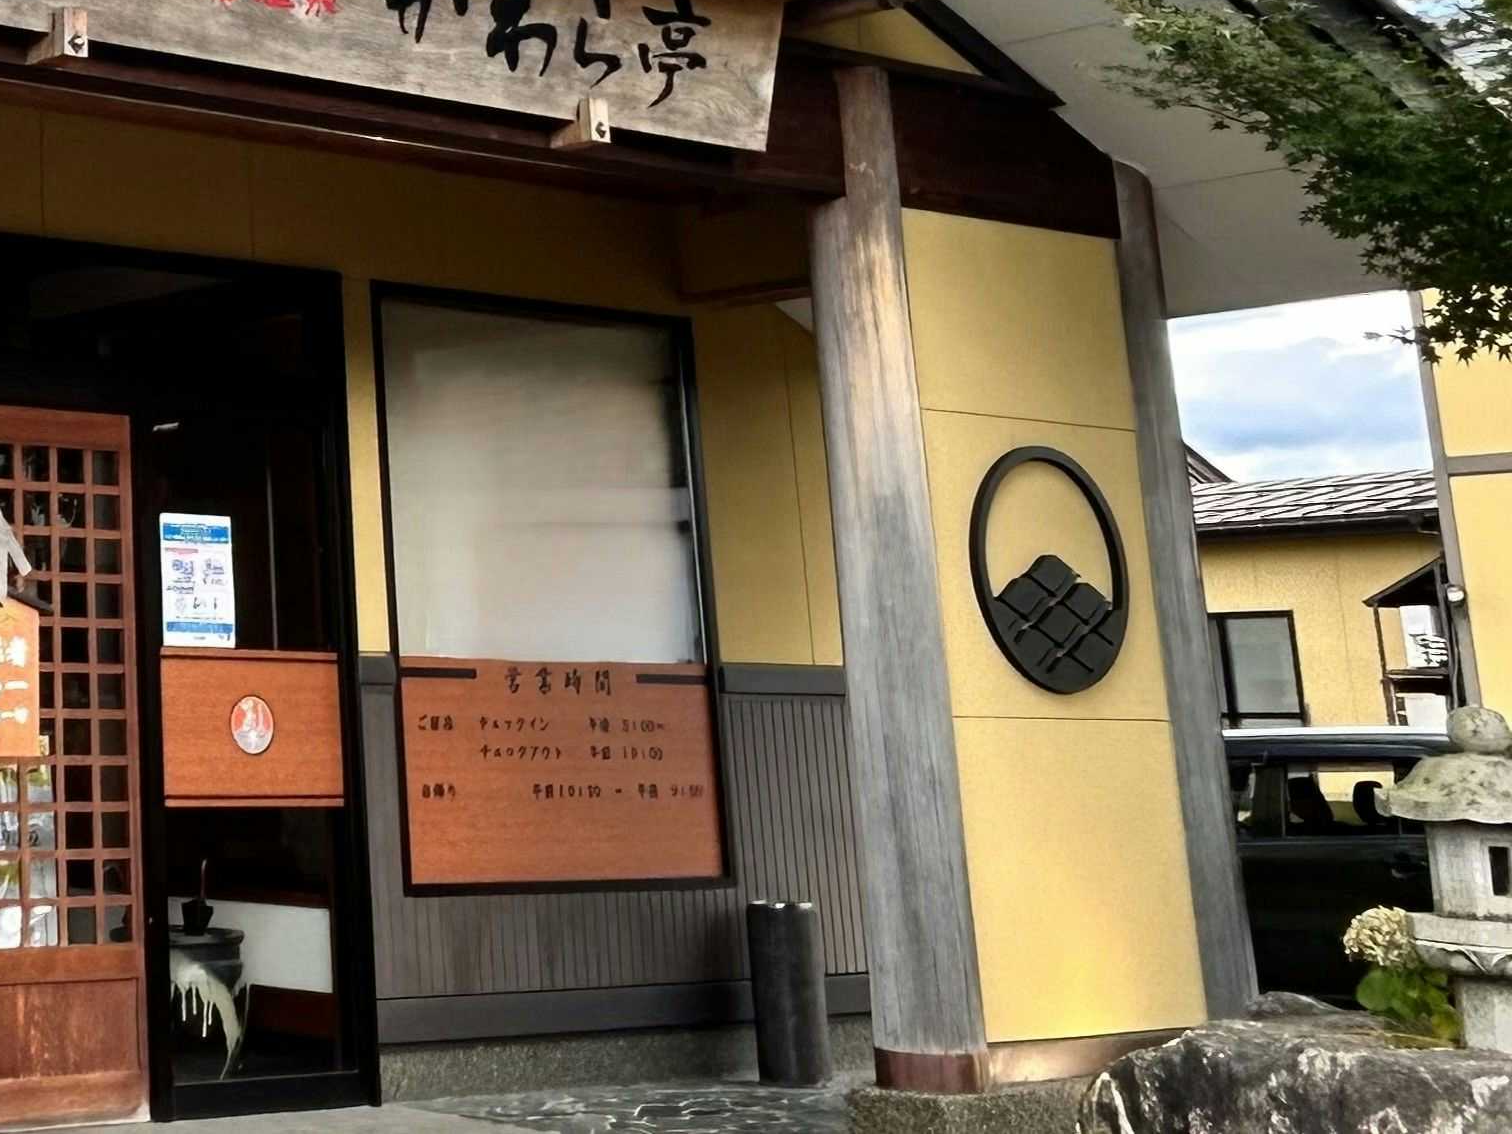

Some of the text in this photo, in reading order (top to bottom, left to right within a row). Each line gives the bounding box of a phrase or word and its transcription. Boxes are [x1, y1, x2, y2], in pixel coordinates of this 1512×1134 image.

[505, 667, 611, 696] 営業時間
[479, 716, 549, 732] チェックイン
[480, 744, 562, 761] チェックアウト
